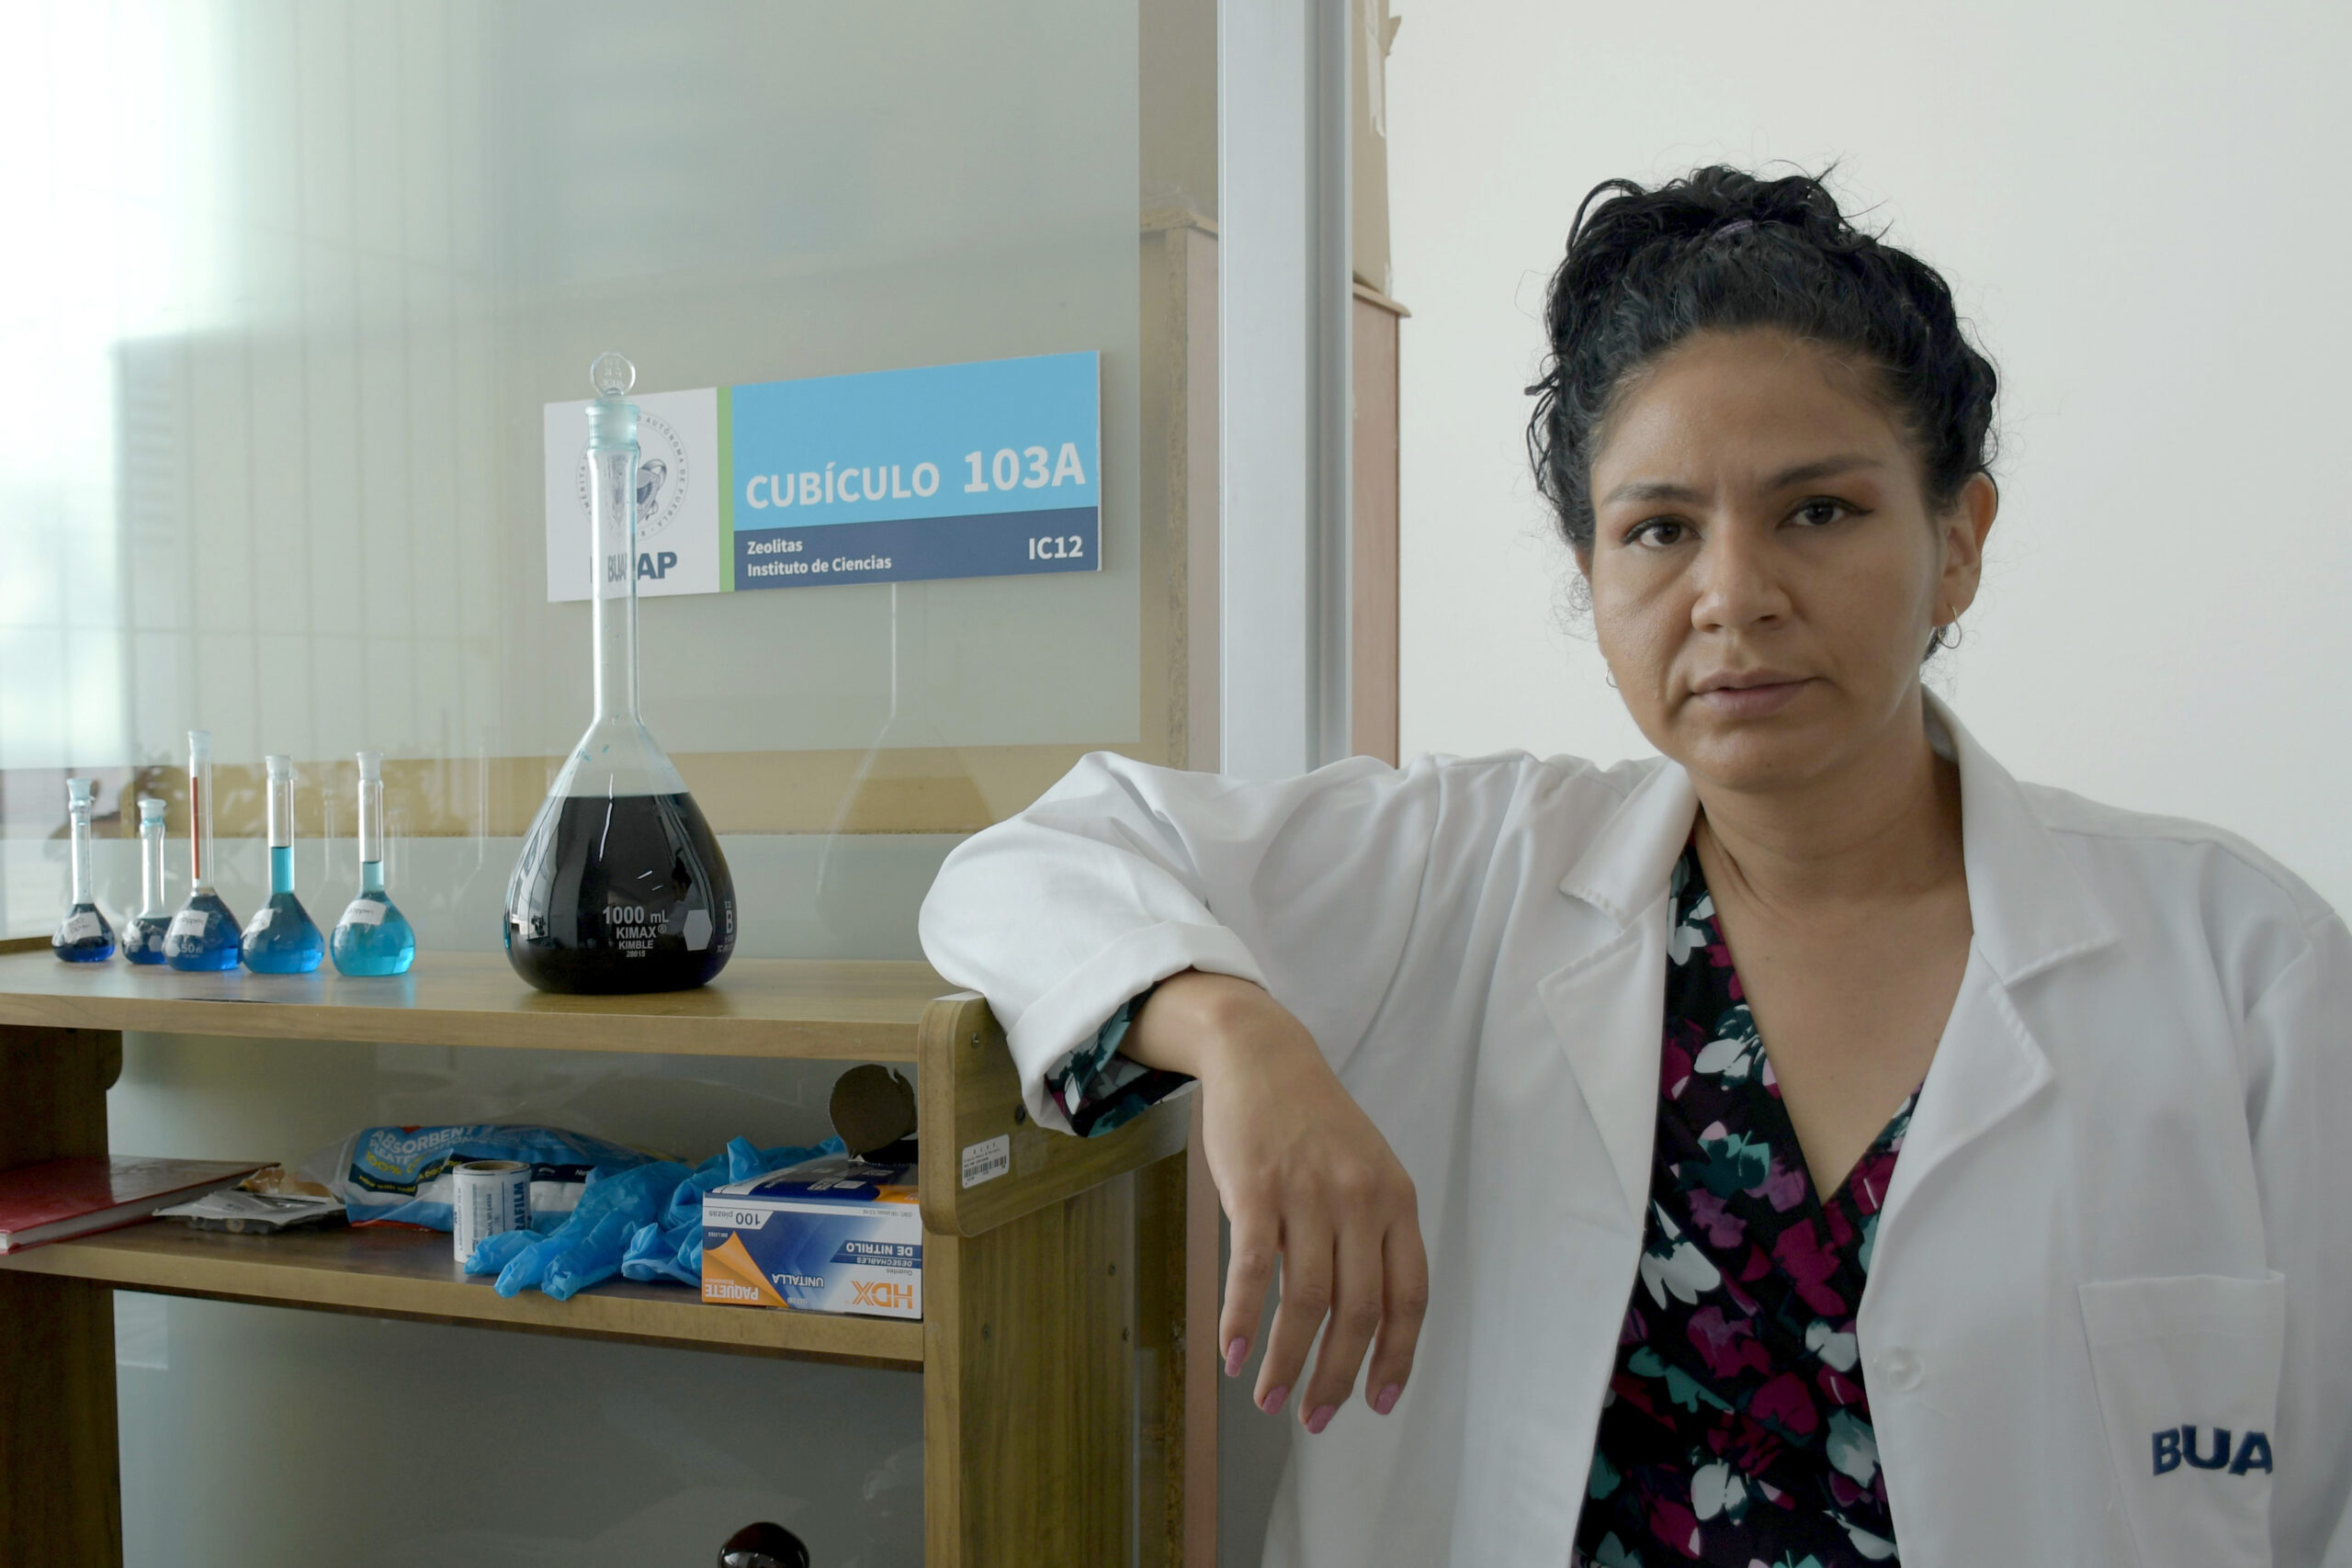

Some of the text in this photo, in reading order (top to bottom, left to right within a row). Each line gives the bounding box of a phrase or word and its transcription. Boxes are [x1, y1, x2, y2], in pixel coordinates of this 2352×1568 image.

[747, 443, 1086, 510] CUBÍCULO 103A
[748, 538, 803, 555] Zeolitas
[1028, 536, 1084, 560] IC12
[747, 556, 892, 578] Instituto de Ciencias
[602, 906, 670, 925] 1000 mL
[181, 943, 195, 953] 50
[618, 940, 654, 950] KIMBLE
[625, 950, 646, 958] 28015
[371, 1126, 477, 1155] ABSORBENT
[708, 1211, 762, 1226] 100 piezas
[846, 1242, 913, 1257] DE NITRILO
[856, 1257, 913, 1268] DESECHABLES
[771, 1273, 824, 1288] UNITALLA
[705, 1284, 759, 1301] PAQUETE
[851, 1280, 913, 1309] HDX
